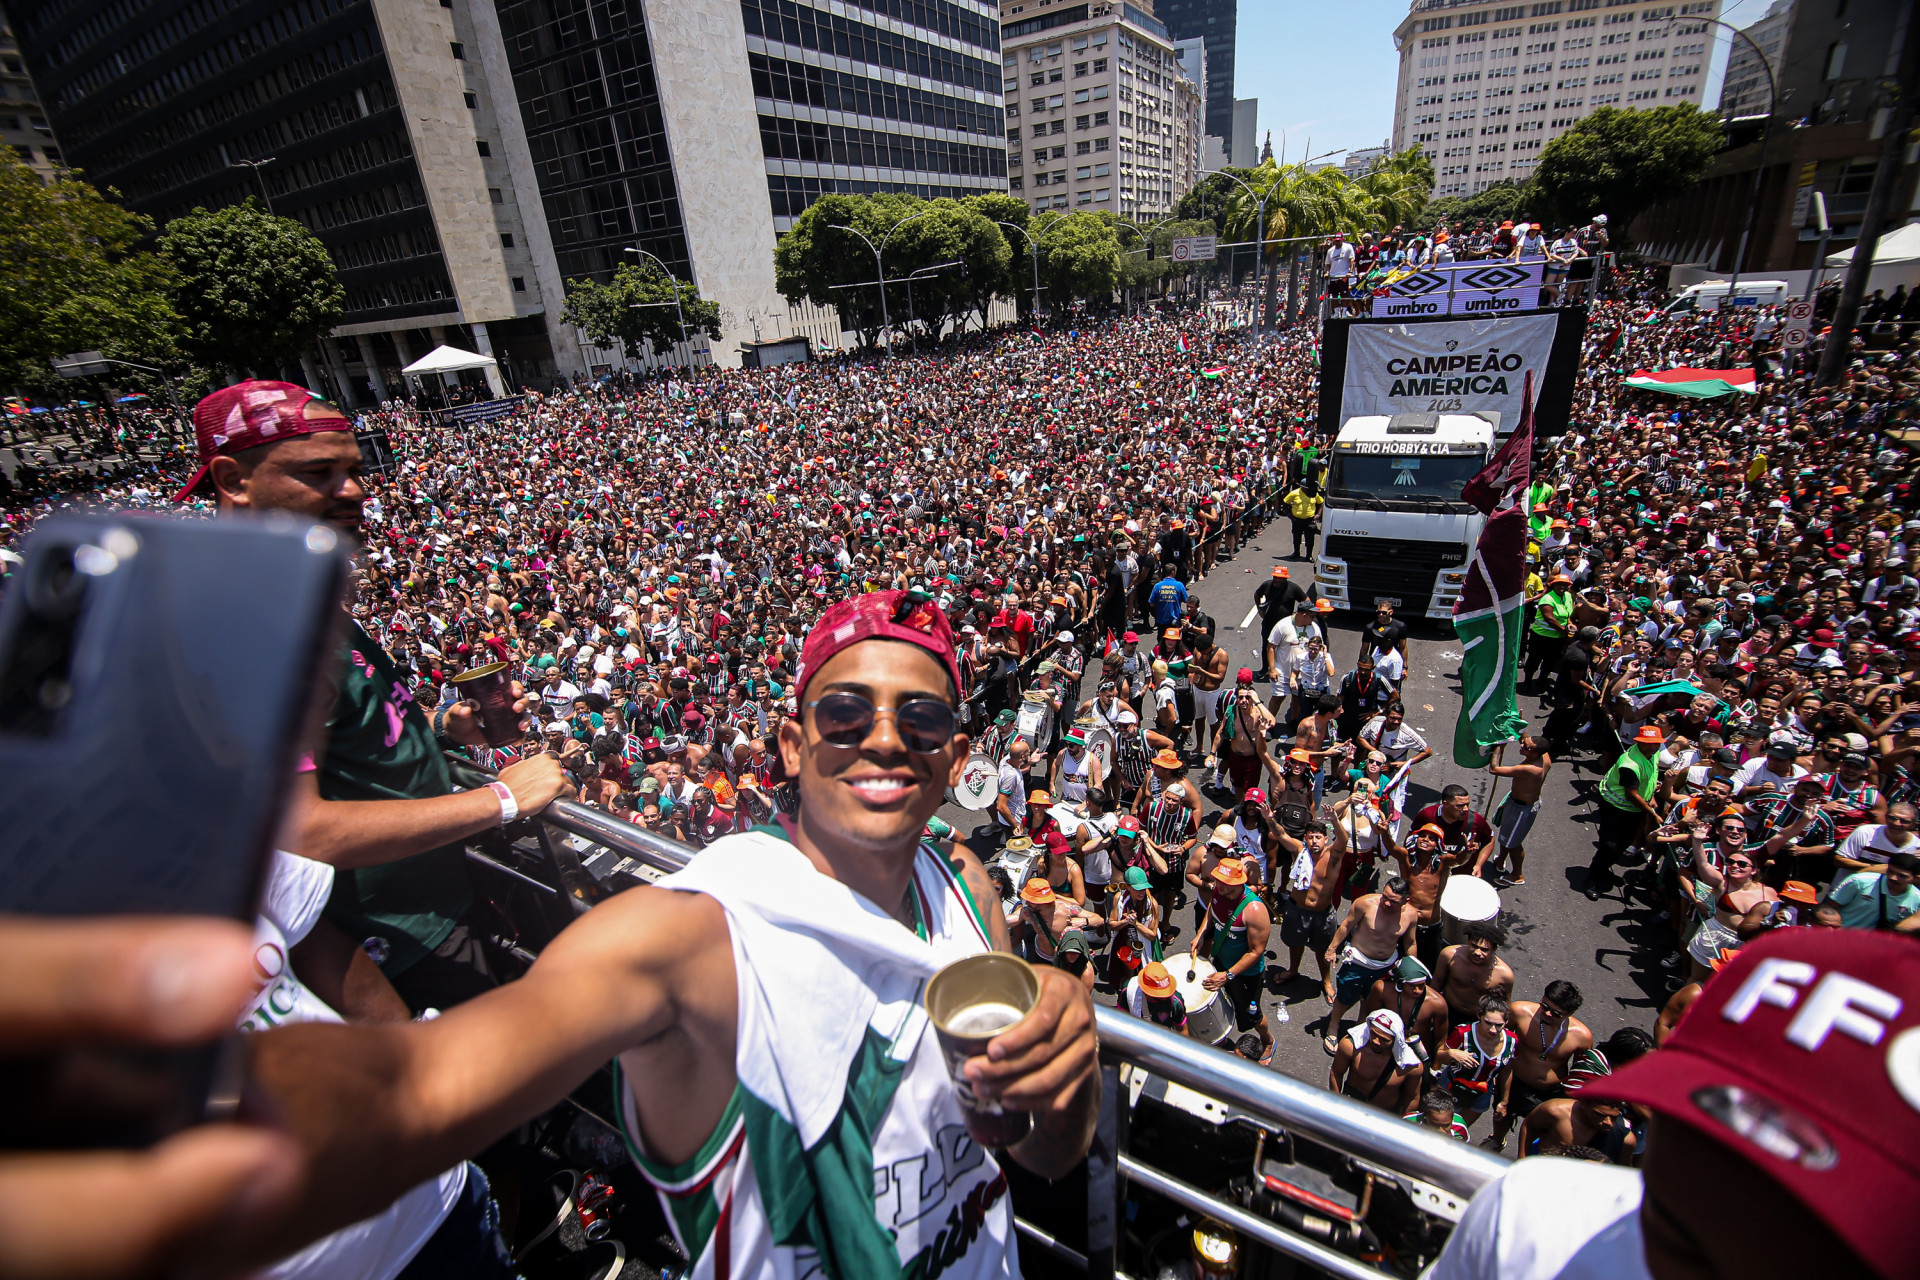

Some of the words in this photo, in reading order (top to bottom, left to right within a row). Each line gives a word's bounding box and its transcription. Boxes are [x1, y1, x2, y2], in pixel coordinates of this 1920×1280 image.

[1387, 302, 1438, 316] umbro
[1465, 297, 1520, 312] umbro
[1386, 348, 1522, 375] CAMPEÃO
[1388, 372, 1508, 397] AMÉRICA
[1427, 398, 1462, 412] 2023
[1356, 442, 1380, 454] TRIO
[1382, 443, 1420, 454] HOBBY
[1420, 444, 1428, 454] &
[1430, 444, 1450, 454] CIA
